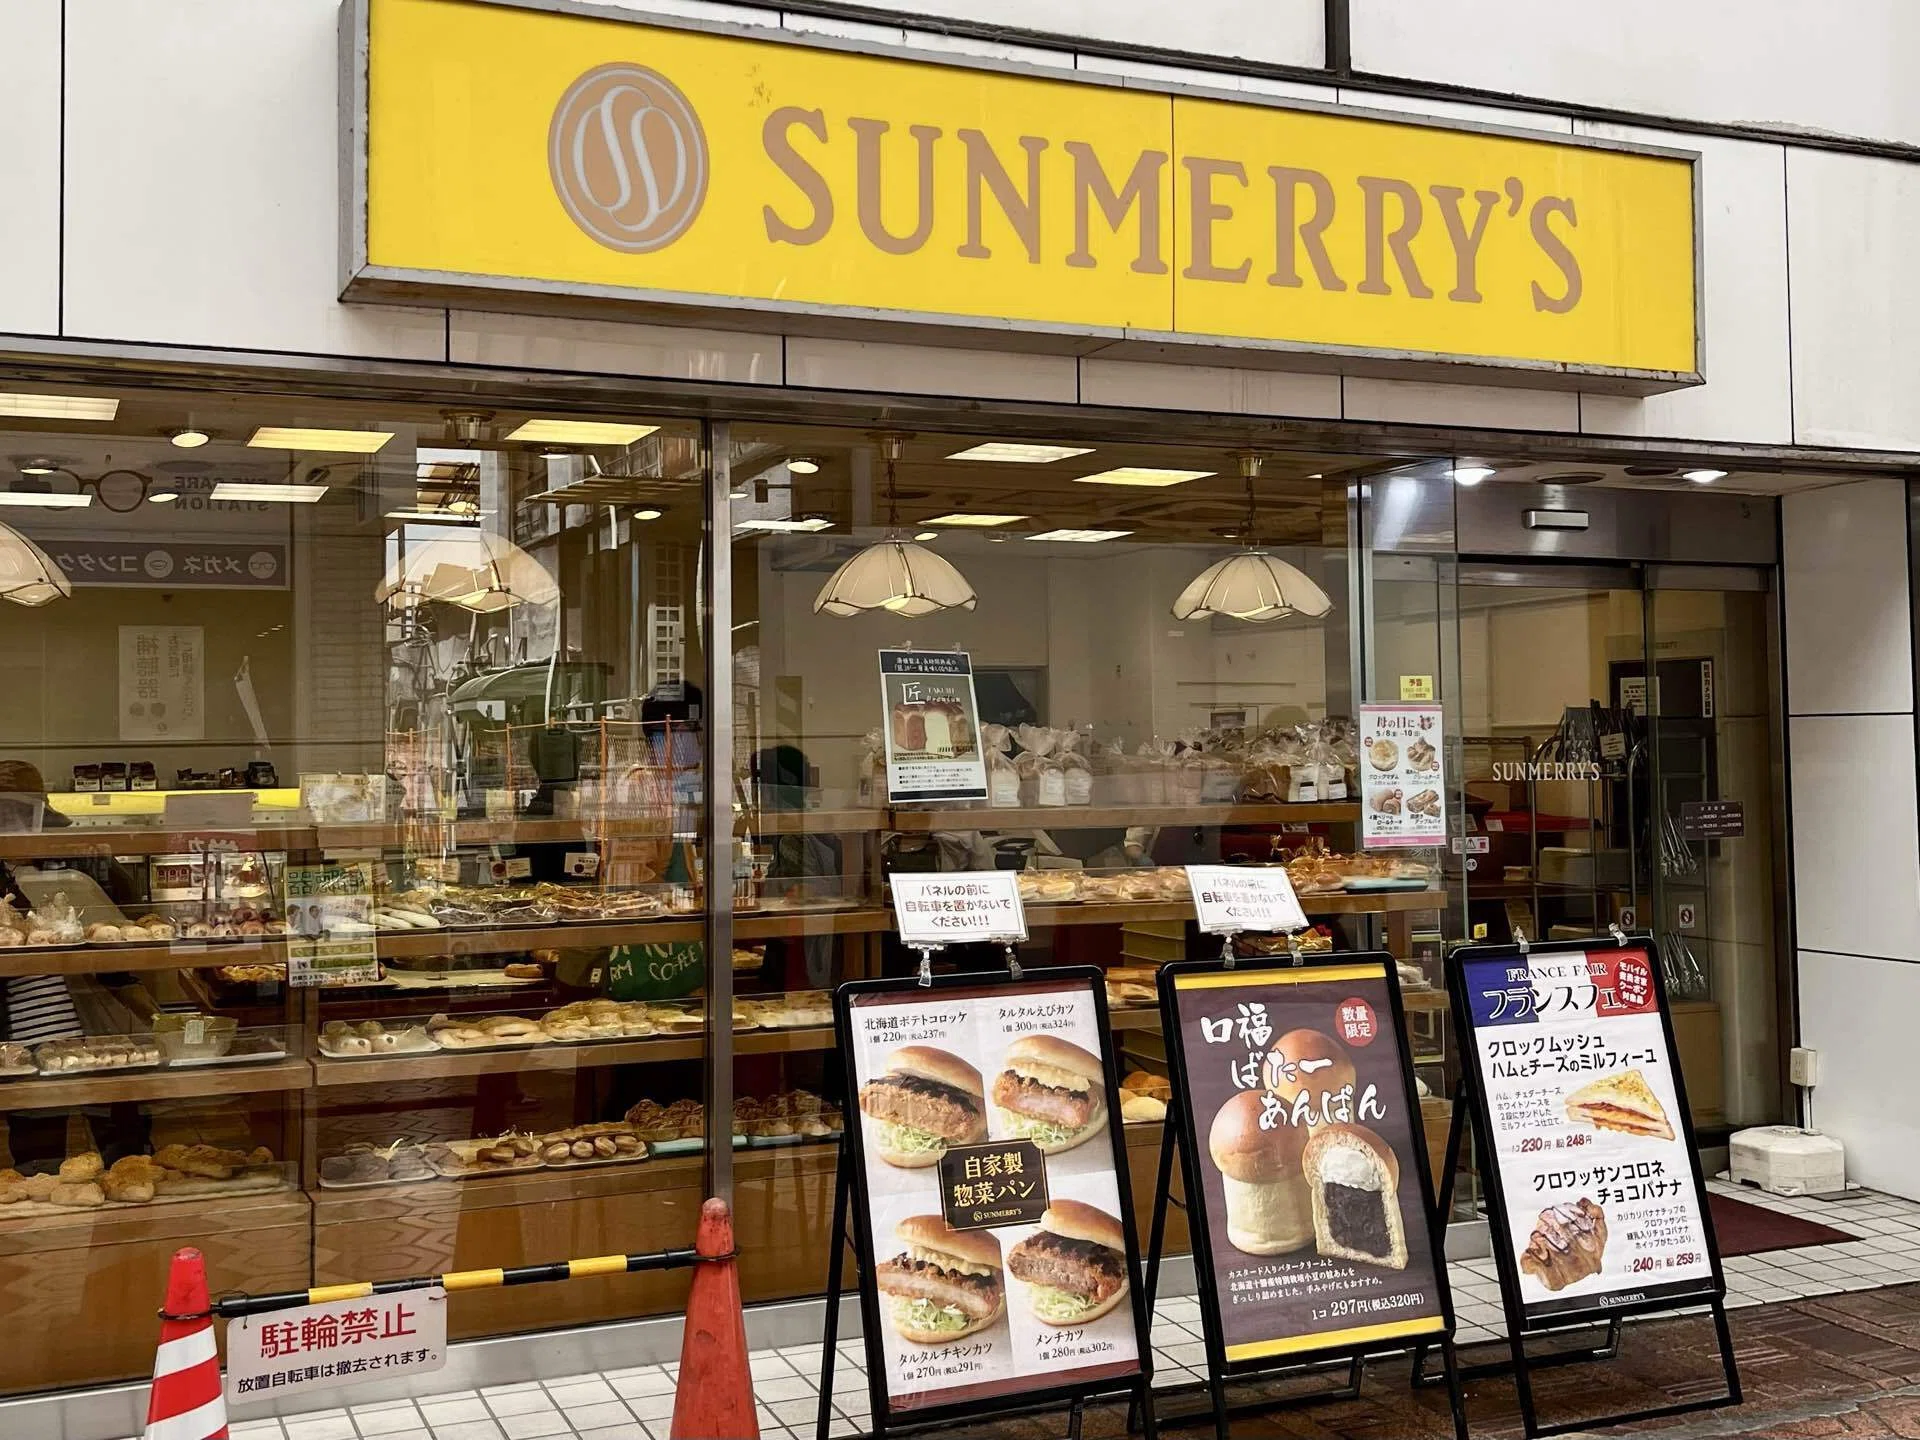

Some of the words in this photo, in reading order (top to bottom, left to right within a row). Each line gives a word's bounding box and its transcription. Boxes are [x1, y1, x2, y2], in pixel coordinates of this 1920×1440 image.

[762, 105, 1583, 314] SUNMERRY'S
[902, 681, 925, 705] 匠
[1492, 761, 1600, 782] SUNMERRY'S
[920, 883, 990, 896] パネルの前に
[905, 899, 1011, 913] 自転車を置かないで
[930, 915, 990, 928] ください!!!
[1506, 965, 1567, 982] FRANCE
[1573, 962, 1609, 977] FAIR
[998, 1004, 1074, 1020] タルタルえびカツ
[1341, 1005, 1369, 1023] 数量
[1483, 984, 1629, 1020] フランスフェ
[864, 1012, 968, 1031] 北海道ポテトコロッケ
[1200, 1002, 1273, 1048] 口福
[1344, 1022, 1373, 1039] 限定
[1488, 1034, 1605, 1058] クロックムッシュ
[1230, 1048, 1333, 1090] ばたー
[1491, 1047, 1657, 1079] ハムとチーズのミルフィーユ
[1258, 1083, 1387, 1132] あんぱん
[1497, 1098, 1553, 1111] ホワイトソースを
[1500, 1108, 1554, 1121] 2段にサンドした
[964, 1151, 1024, 1180] 自家製
[1533, 1159, 1666, 1192] クロワッサンコロネ
[953, 1179, 1036, 1207] 惣菜パン
[1597, 1178, 1683, 1205] チョコバナナ
[983, 1208, 1022, 1219] SUNMERRY'S
[1643, 1215, 1688, 1229] クロワッサンに
[260, 1303, 417, 1359] 駐輪禁止
[1035, 1328, 1084, 1347] メンチカツ
[898, 1341, 993, 1367] タルタルチキンカツ
[237, 1347, 438, 1394] 放置自転車は撤去されます。
